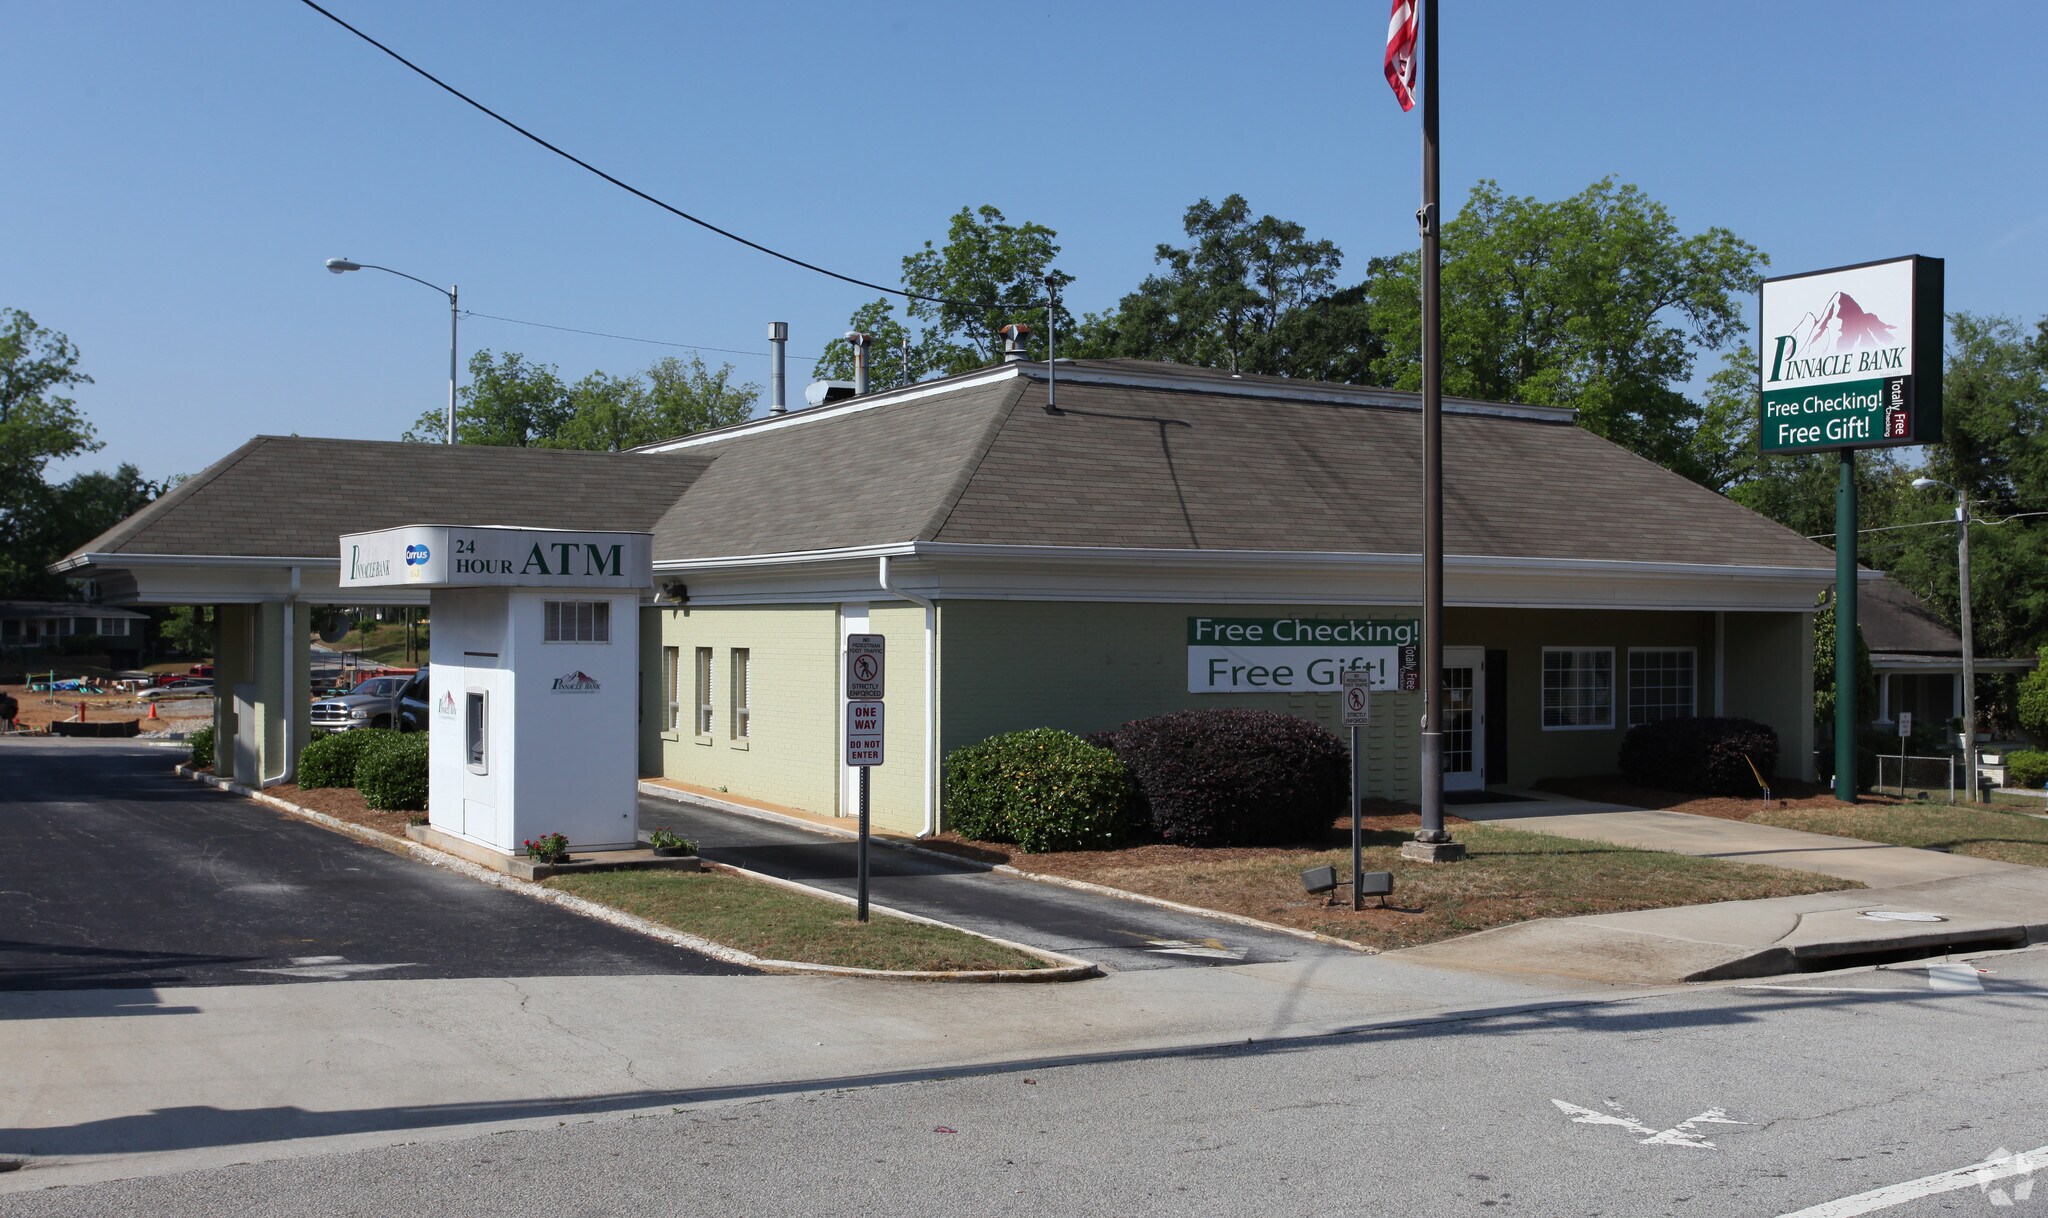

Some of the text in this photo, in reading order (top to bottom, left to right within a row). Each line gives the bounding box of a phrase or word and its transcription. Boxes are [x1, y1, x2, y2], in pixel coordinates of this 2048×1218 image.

[1767, 335, 1907, 383] PINNACLE BANK
[1767, 390, 1883, 417] Free Checking!
[1891, 378, 1903, 411] Totally
[1779, 416, 1869, 445] Free Gift!
[1884, 406, 1893, 438] Checking
[1894, 413, 1906, 435] Free
[456, 539, 475, 554] 24
[456, 542, 625, 576] HOUR ATM
[375, 559, 390, 577] BANK
[1196, 618, 1419, 646] Free Checking!
[1209, 658, 1294, 687] Free
[1405, 645, 1417, 690] Totally Free
[855, 707, 876, 717] ONE
[855, 720, 877, 729] WAY
[852, 751, 879, 759] ENTER
